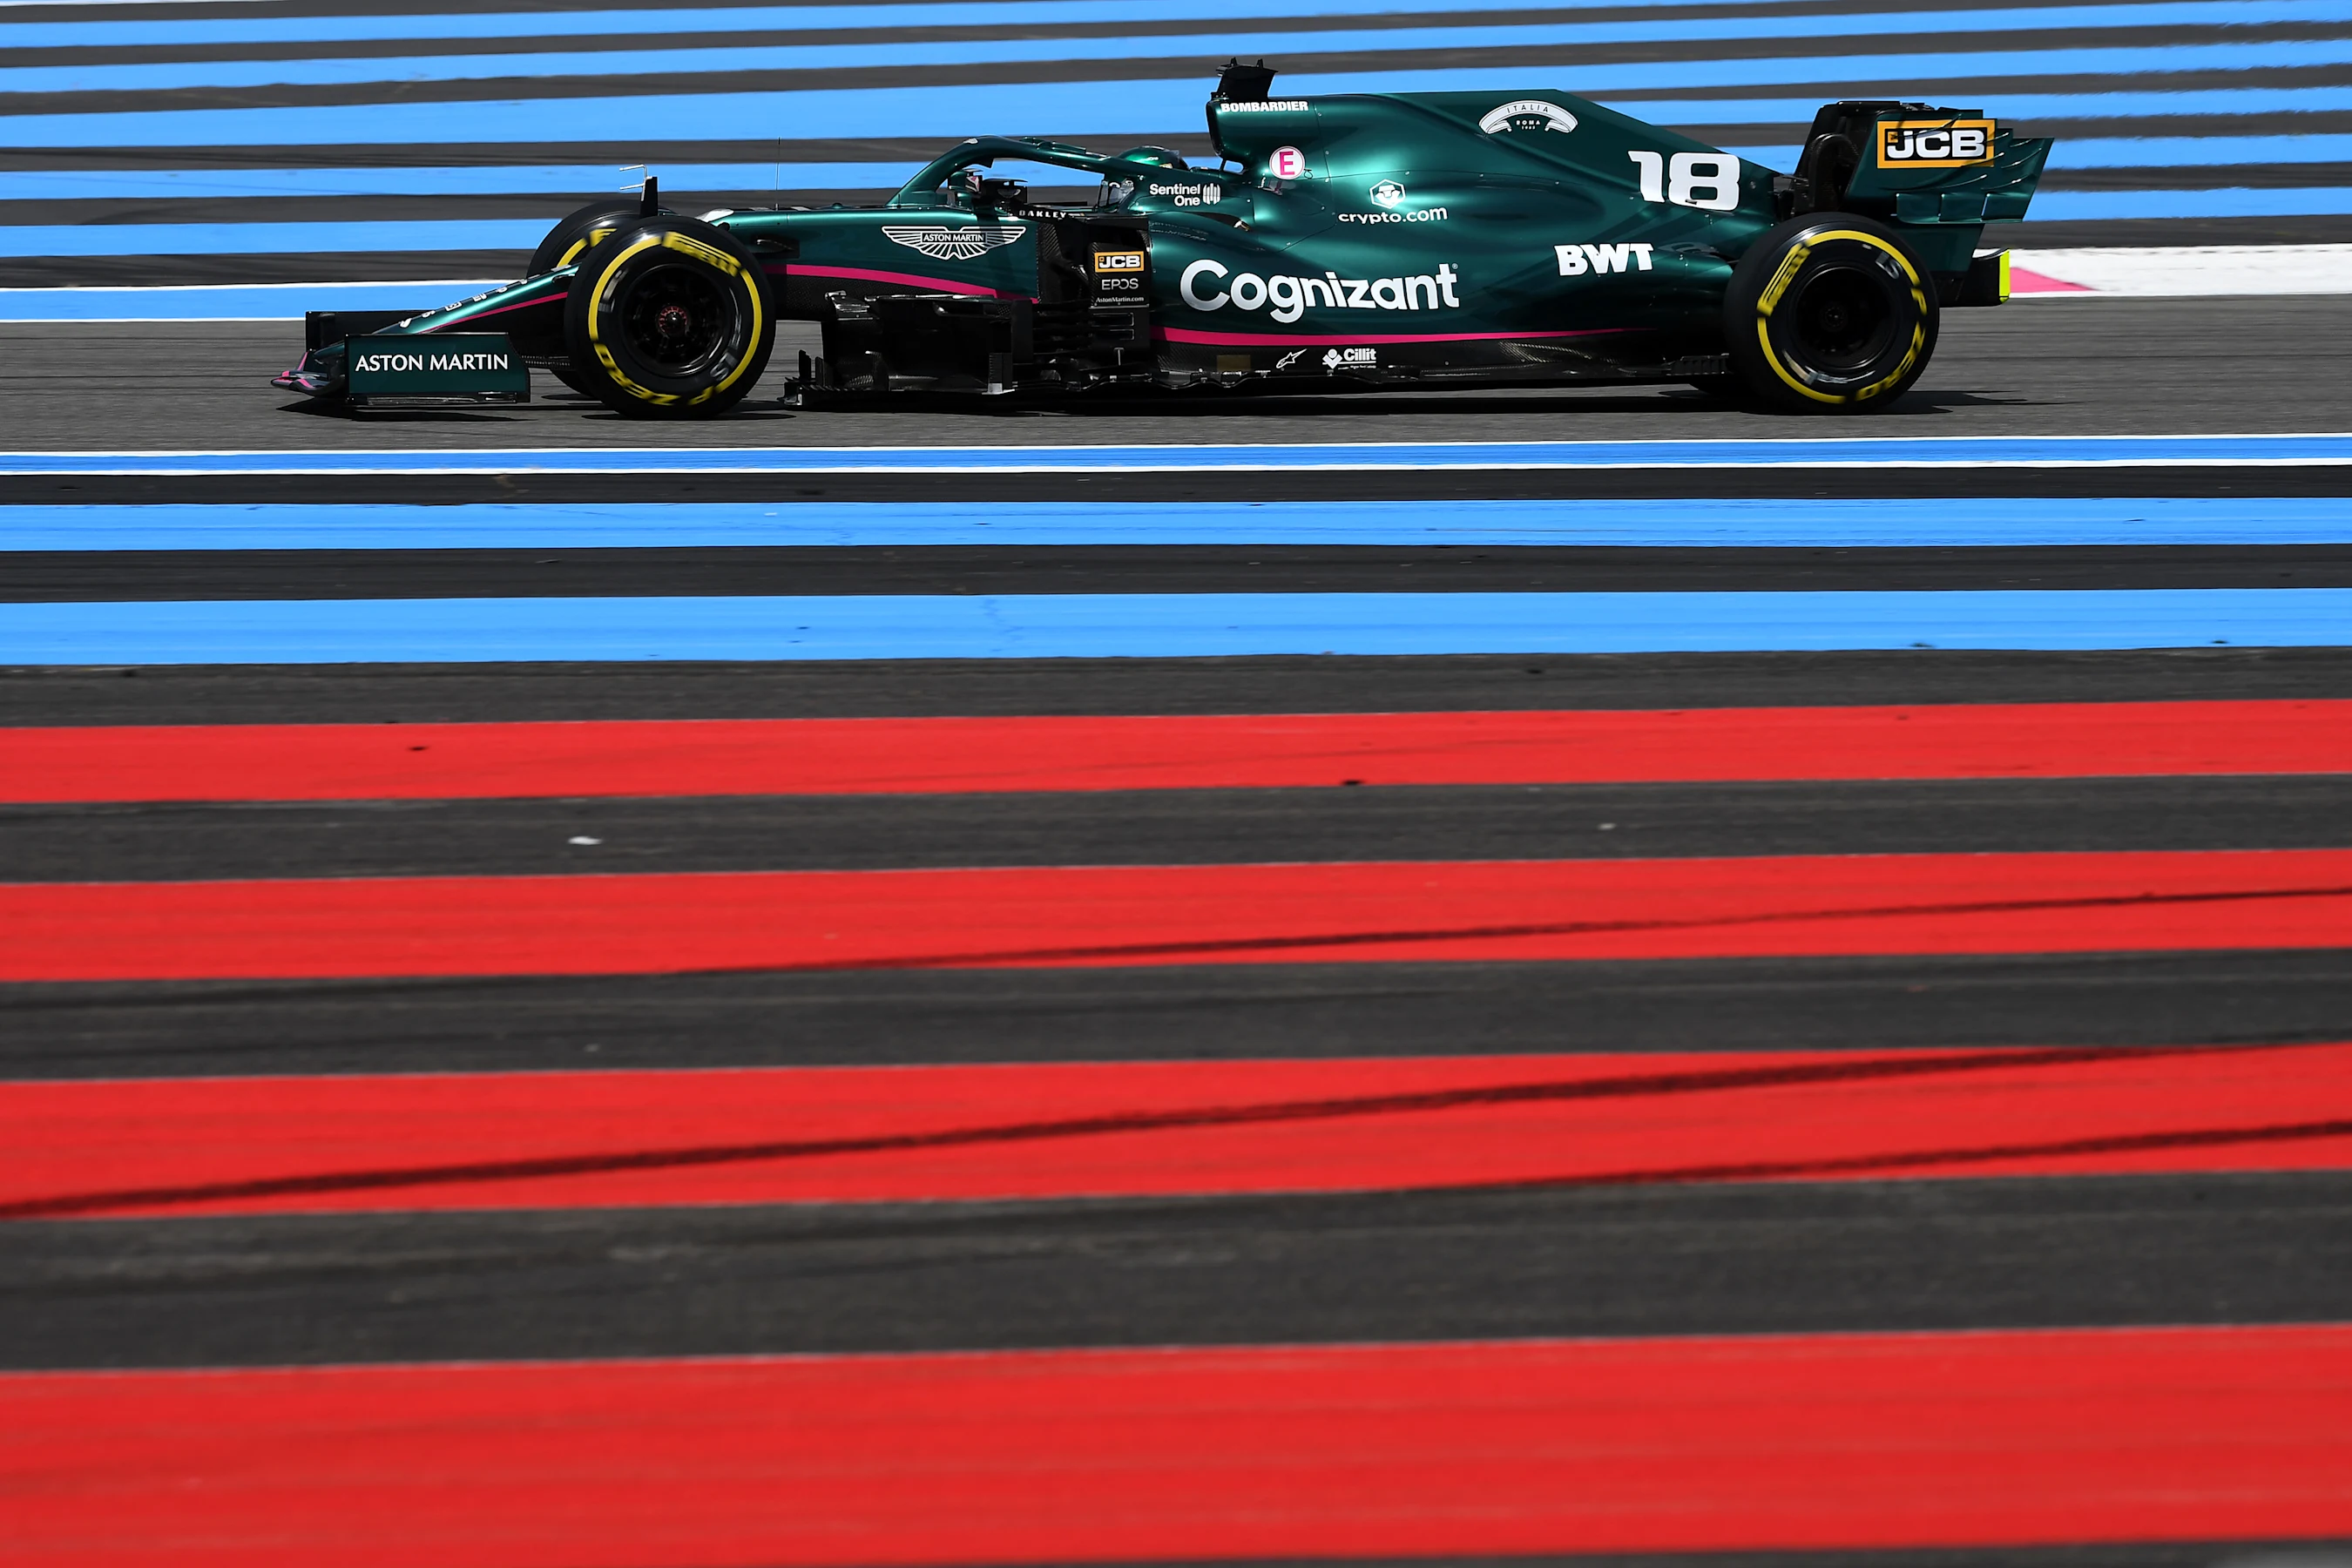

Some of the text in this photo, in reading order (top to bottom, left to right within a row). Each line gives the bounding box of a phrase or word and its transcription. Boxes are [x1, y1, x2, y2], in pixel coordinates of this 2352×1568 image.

[1220, 100, 1309, 113] BOMBARDIER
[1506, 104, 1549, 113] ITALIA
[1887, 130, 1985, 159] JCB
[1279, 151, 1295, 175] E
[1627, 148, 1740, 211] 18
[1149, 183, 1201, 196] Sentinel
[1174, 195, 1201, 206] One
[1018, 209, 1068, 220] OAKLEY
[1338, 206, 1448, 225] crypto.com
[922, 233, 985, 243] ASTON MARTIN
[1098, 255, 1140, 268] JCB
[1554, 243, 1654, 276] BWT
[1179, 259, 1460, 323] Cognizant
[1095, 295, 1145, 304] AstonMartin.com
[1343, 348, 1377, 362] Cillit
[355, 353, 510, 372] ASTON MARTIN
